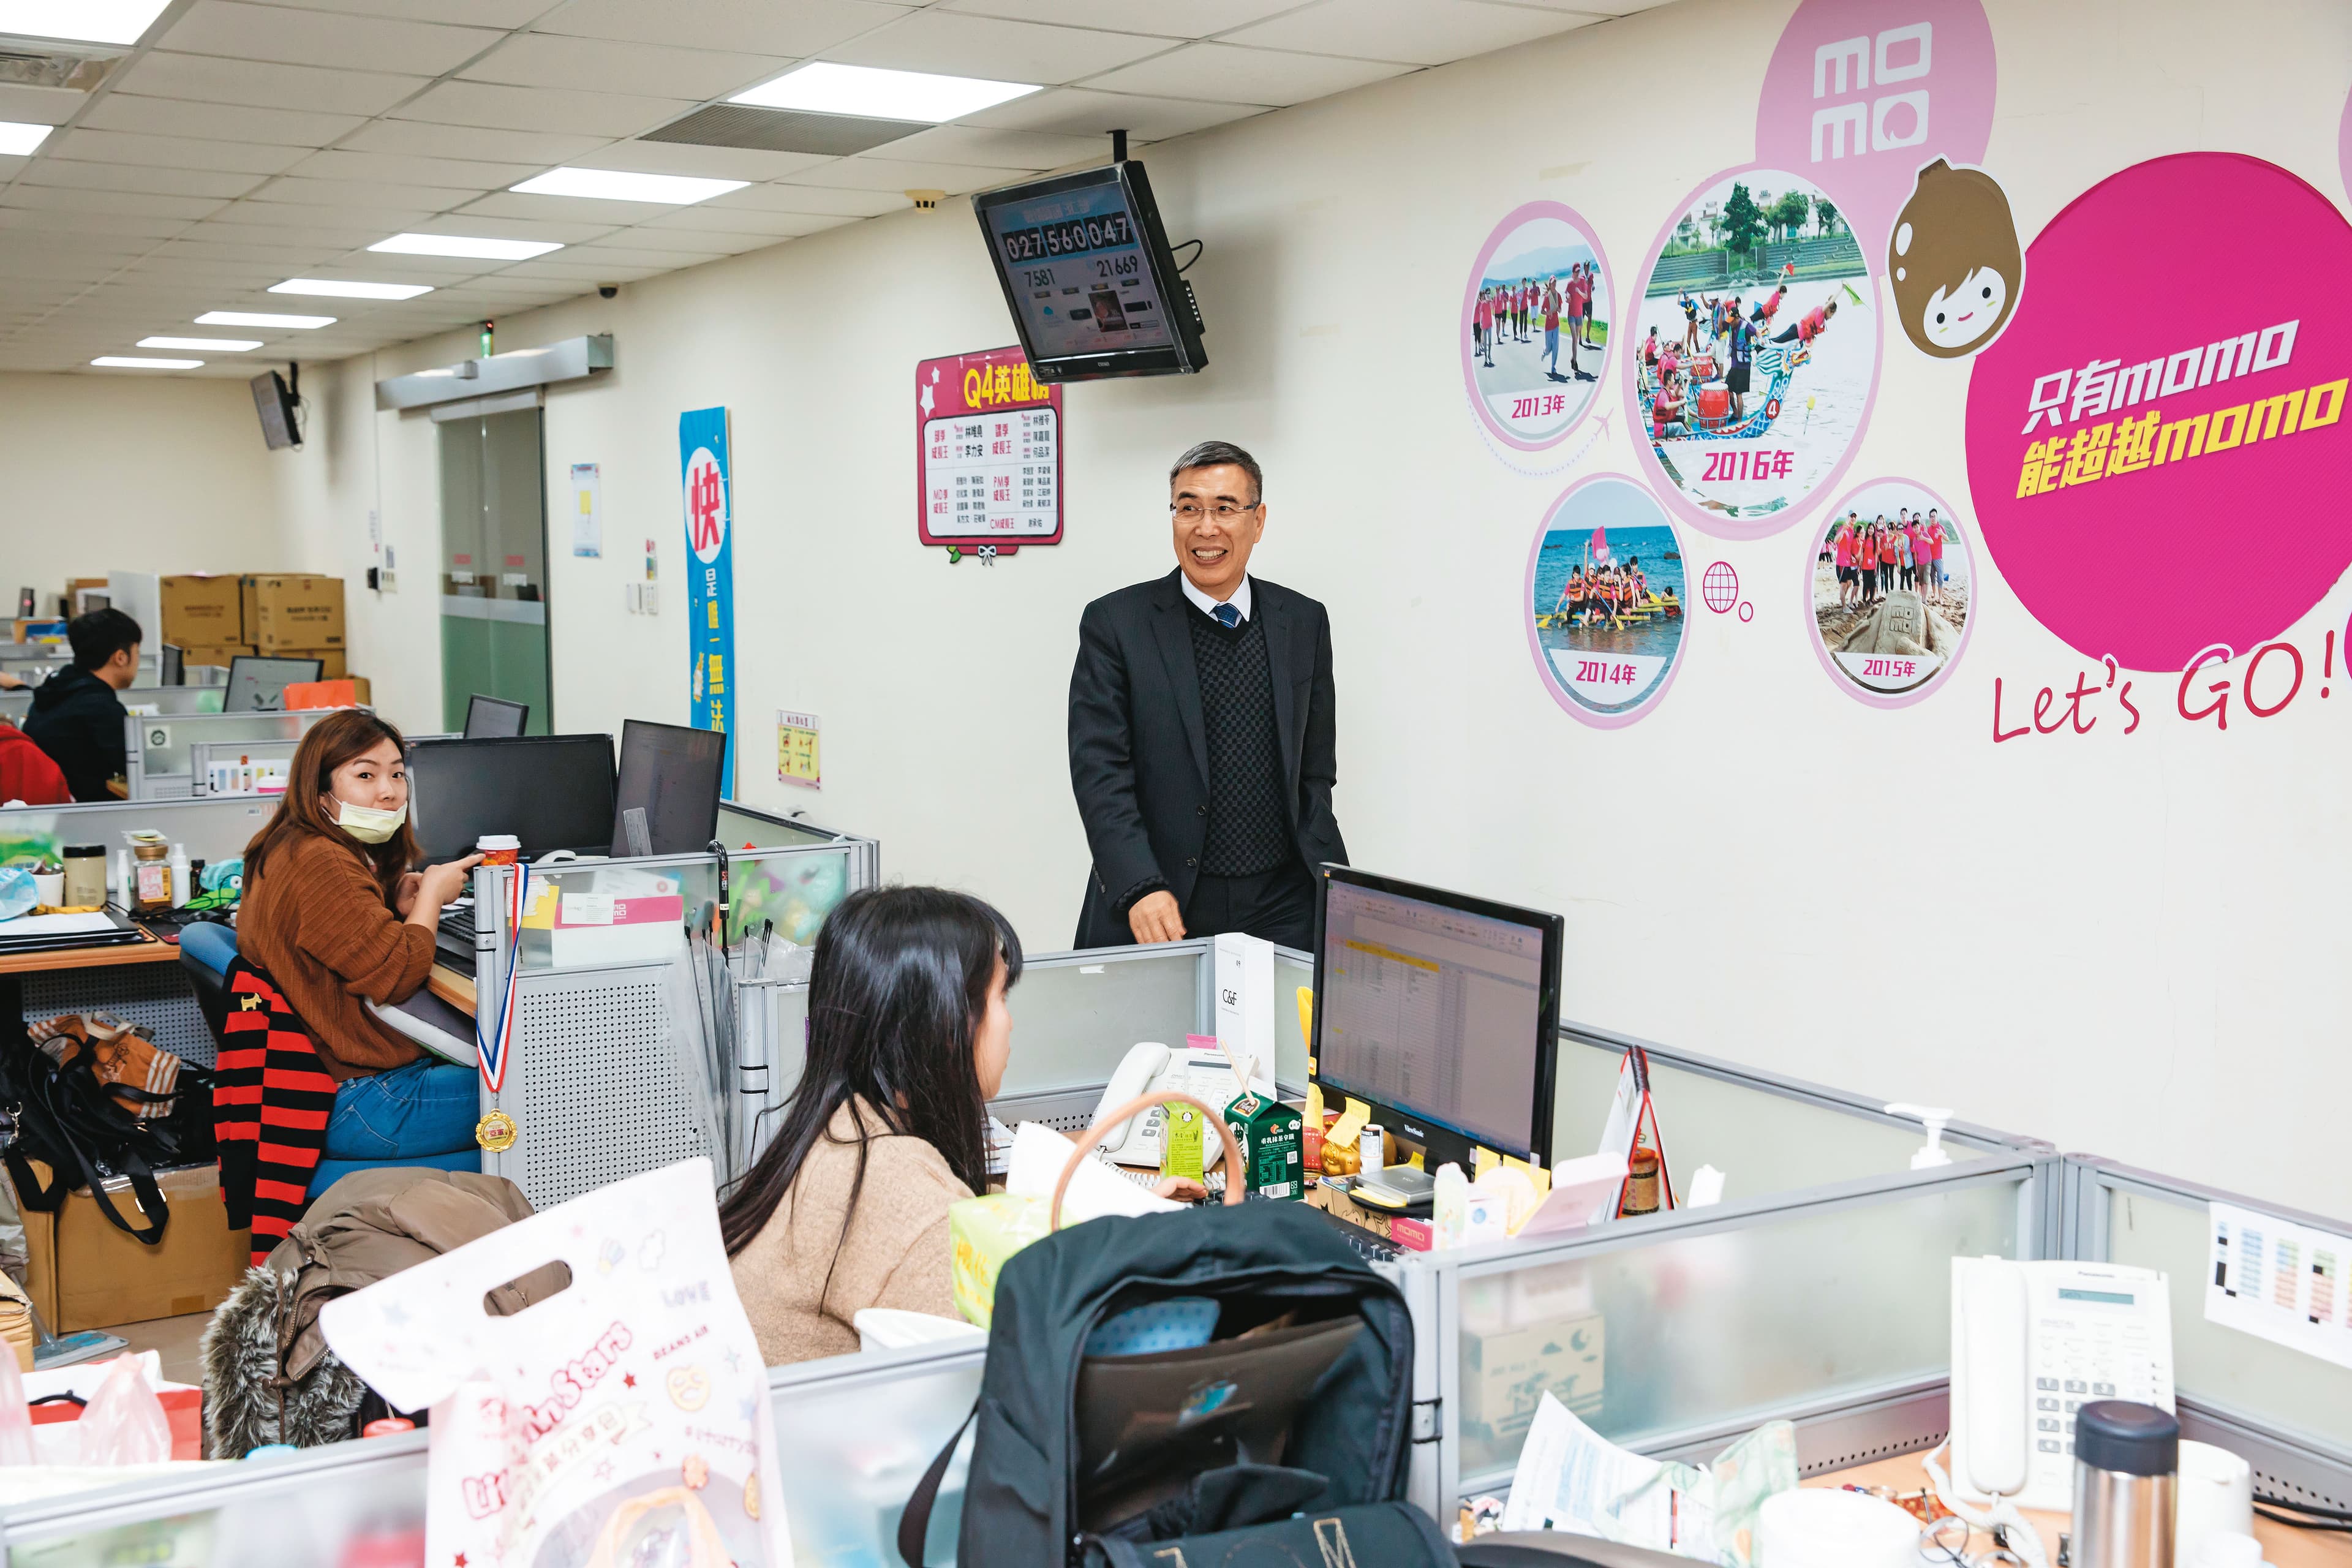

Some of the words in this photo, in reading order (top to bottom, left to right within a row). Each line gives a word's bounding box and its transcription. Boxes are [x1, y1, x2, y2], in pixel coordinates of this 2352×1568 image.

[1024, 268, 1055, 288] 7581
[1096, 255, 1138, 277] 21669
[2022, 319, 2299, 435] 只有momo
[1512, 394, 1566, 418] 2013年
[1768, 401, 1776, 416] 4
[2016, 378, 2350, 499] 能超越momo
[1702, 449, 1794, 481] 2016年
[692, 462, 720, 552] 快
[1575, 660, 1637, 685] 2014年
[1863, 660, 1916, 677] 2015年
[2177, 630, 2334, 730] GO!
[1404, 1124, 1424, 1138] ViewSonic
[662, 1280, 710, 1307] LOVE
